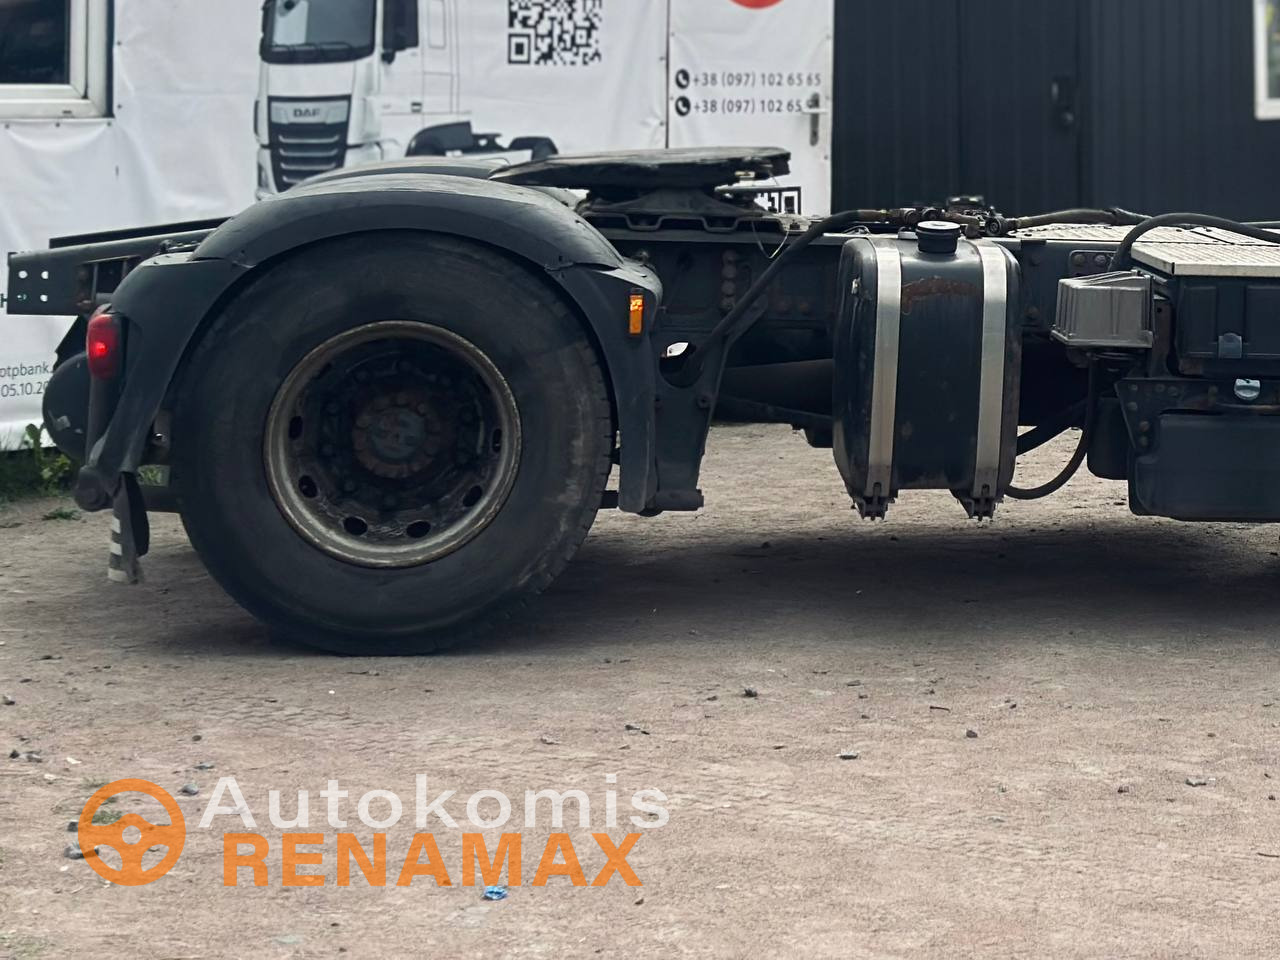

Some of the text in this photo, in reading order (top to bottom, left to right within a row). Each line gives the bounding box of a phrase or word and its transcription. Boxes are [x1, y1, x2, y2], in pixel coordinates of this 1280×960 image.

[693, 72, 821, 88] +38 (097) 102 65 65
[293, 108, 320, 117] DAF
[694, 99, 718, 113] +38
[721, 99, 756, 114] (097)
[760, 100, 783, 113] 102
